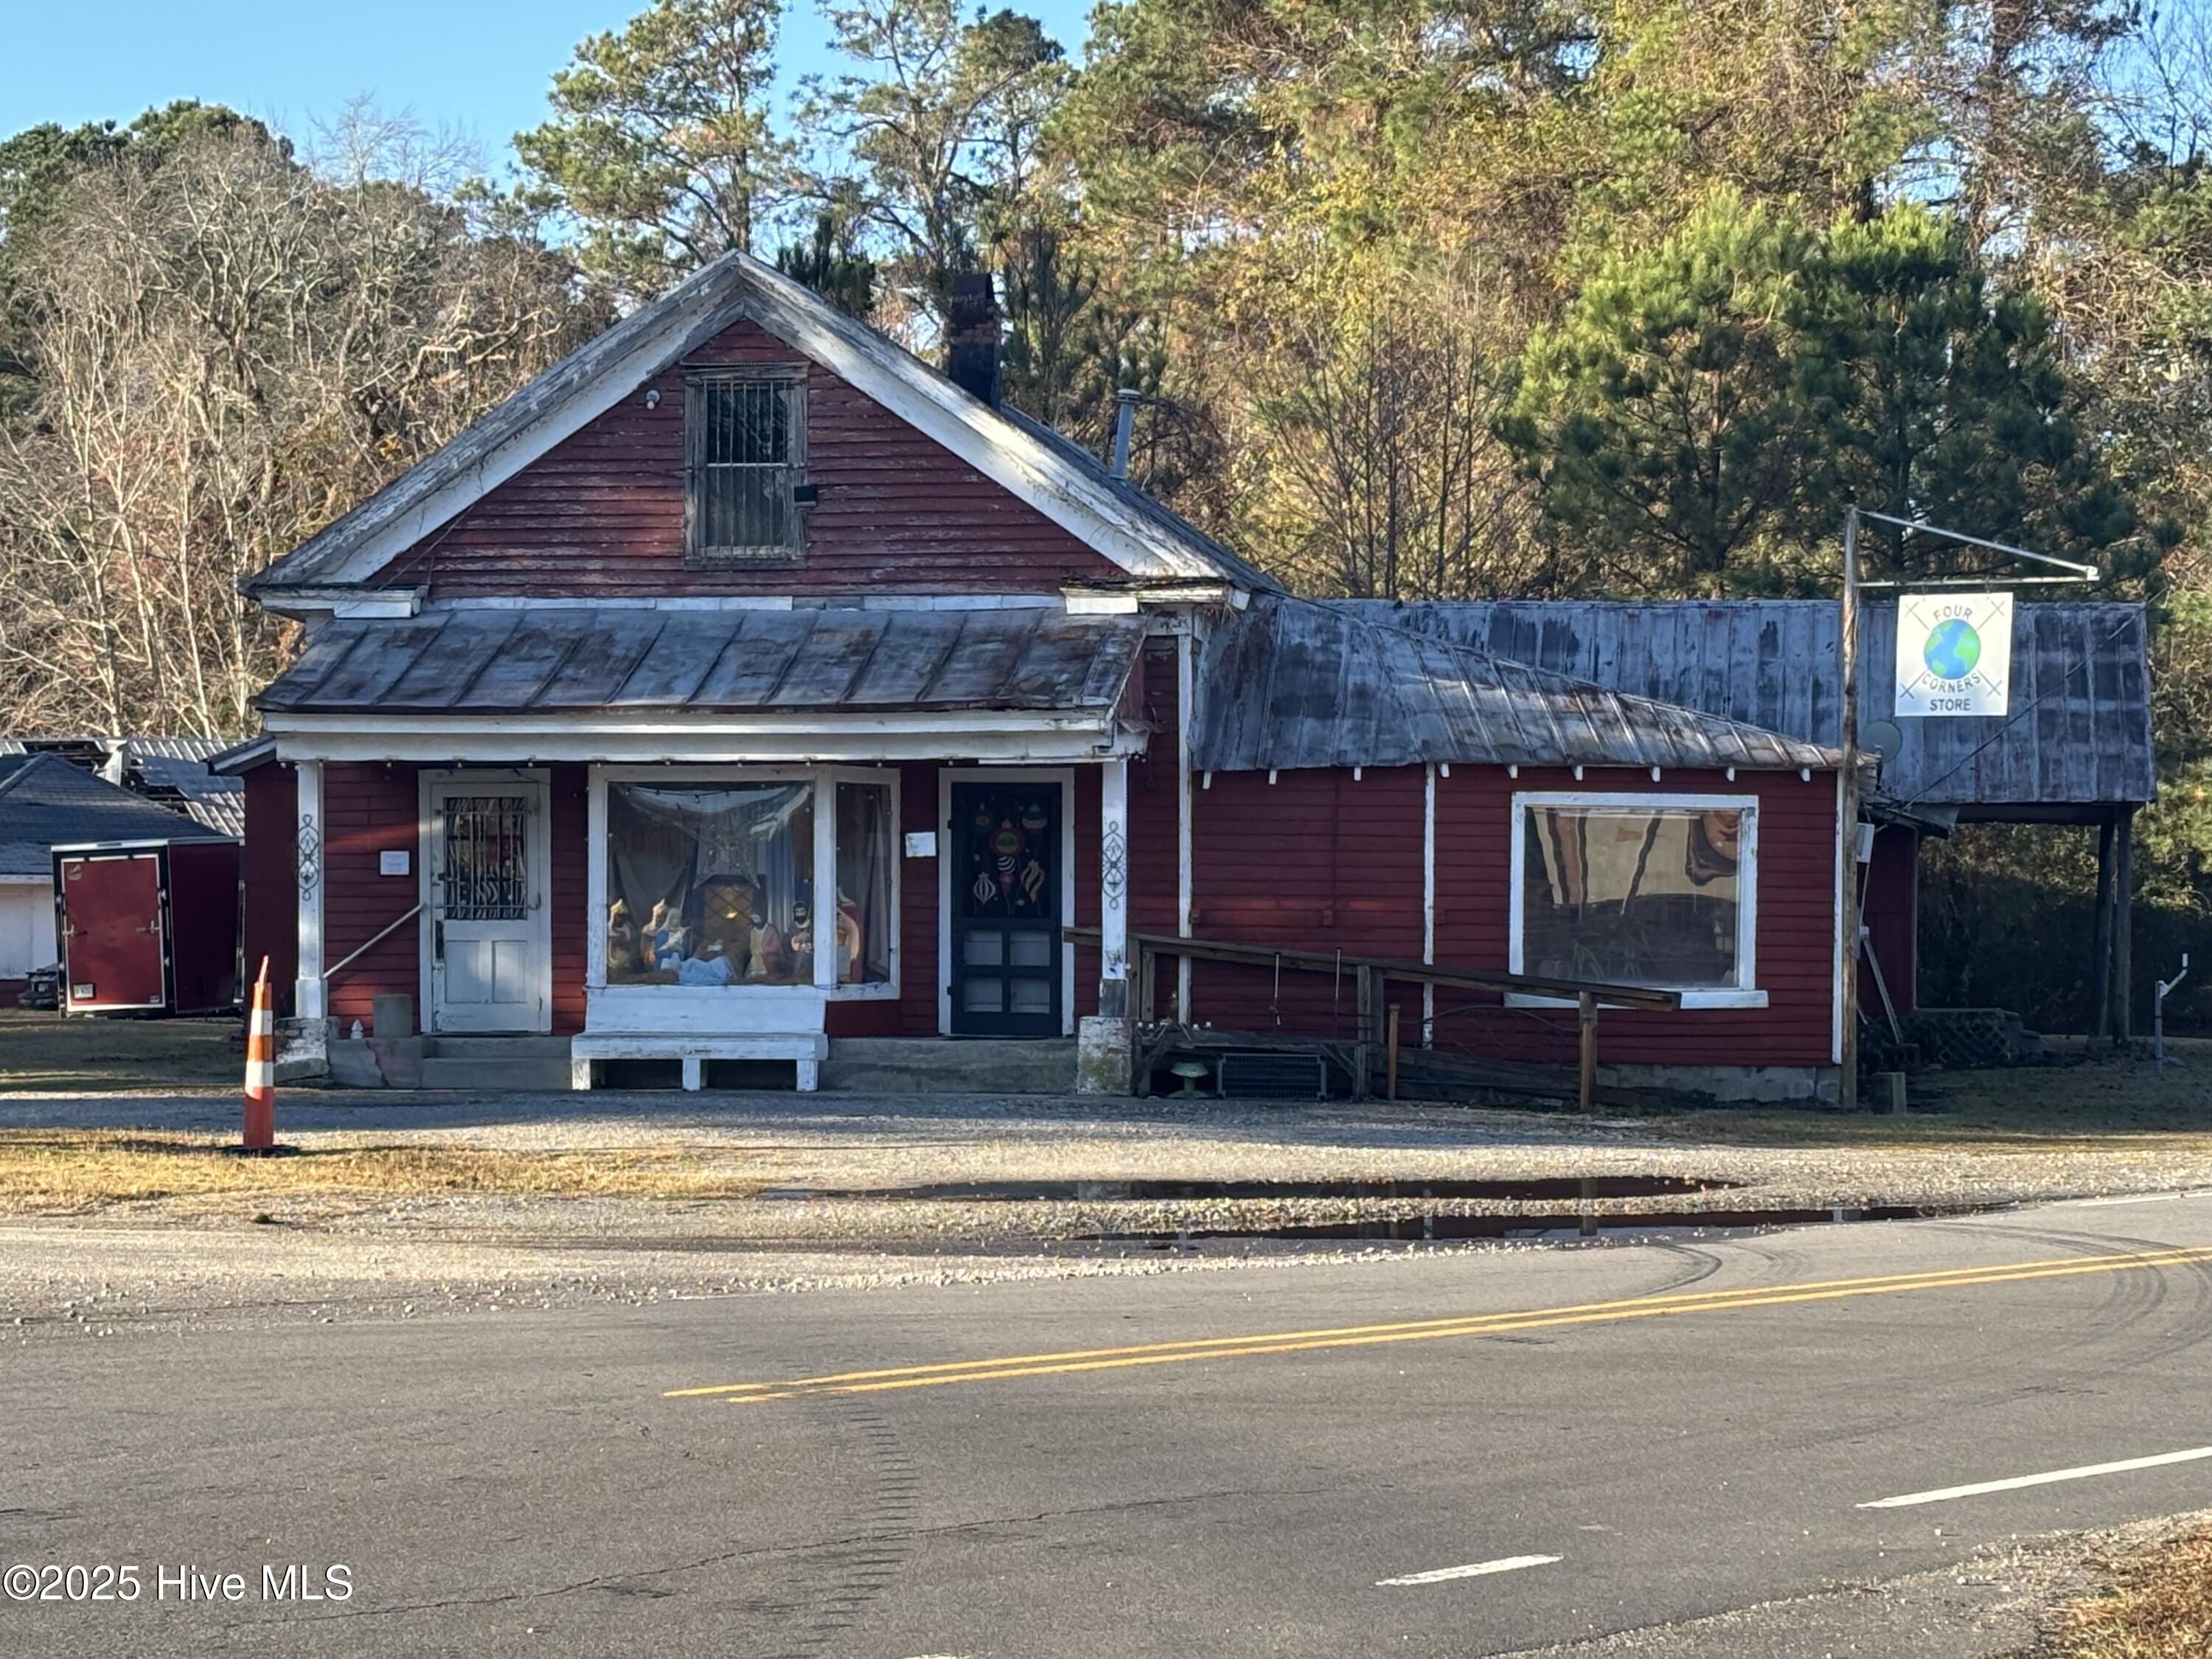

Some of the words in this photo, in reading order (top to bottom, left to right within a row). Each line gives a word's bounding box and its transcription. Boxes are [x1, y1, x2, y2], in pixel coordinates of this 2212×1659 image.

[1933, 605, 1973, 622] FOUR
[1921, 672, 1981, 693] CORNERS
[1929, 698, 1972, 712] STORE
